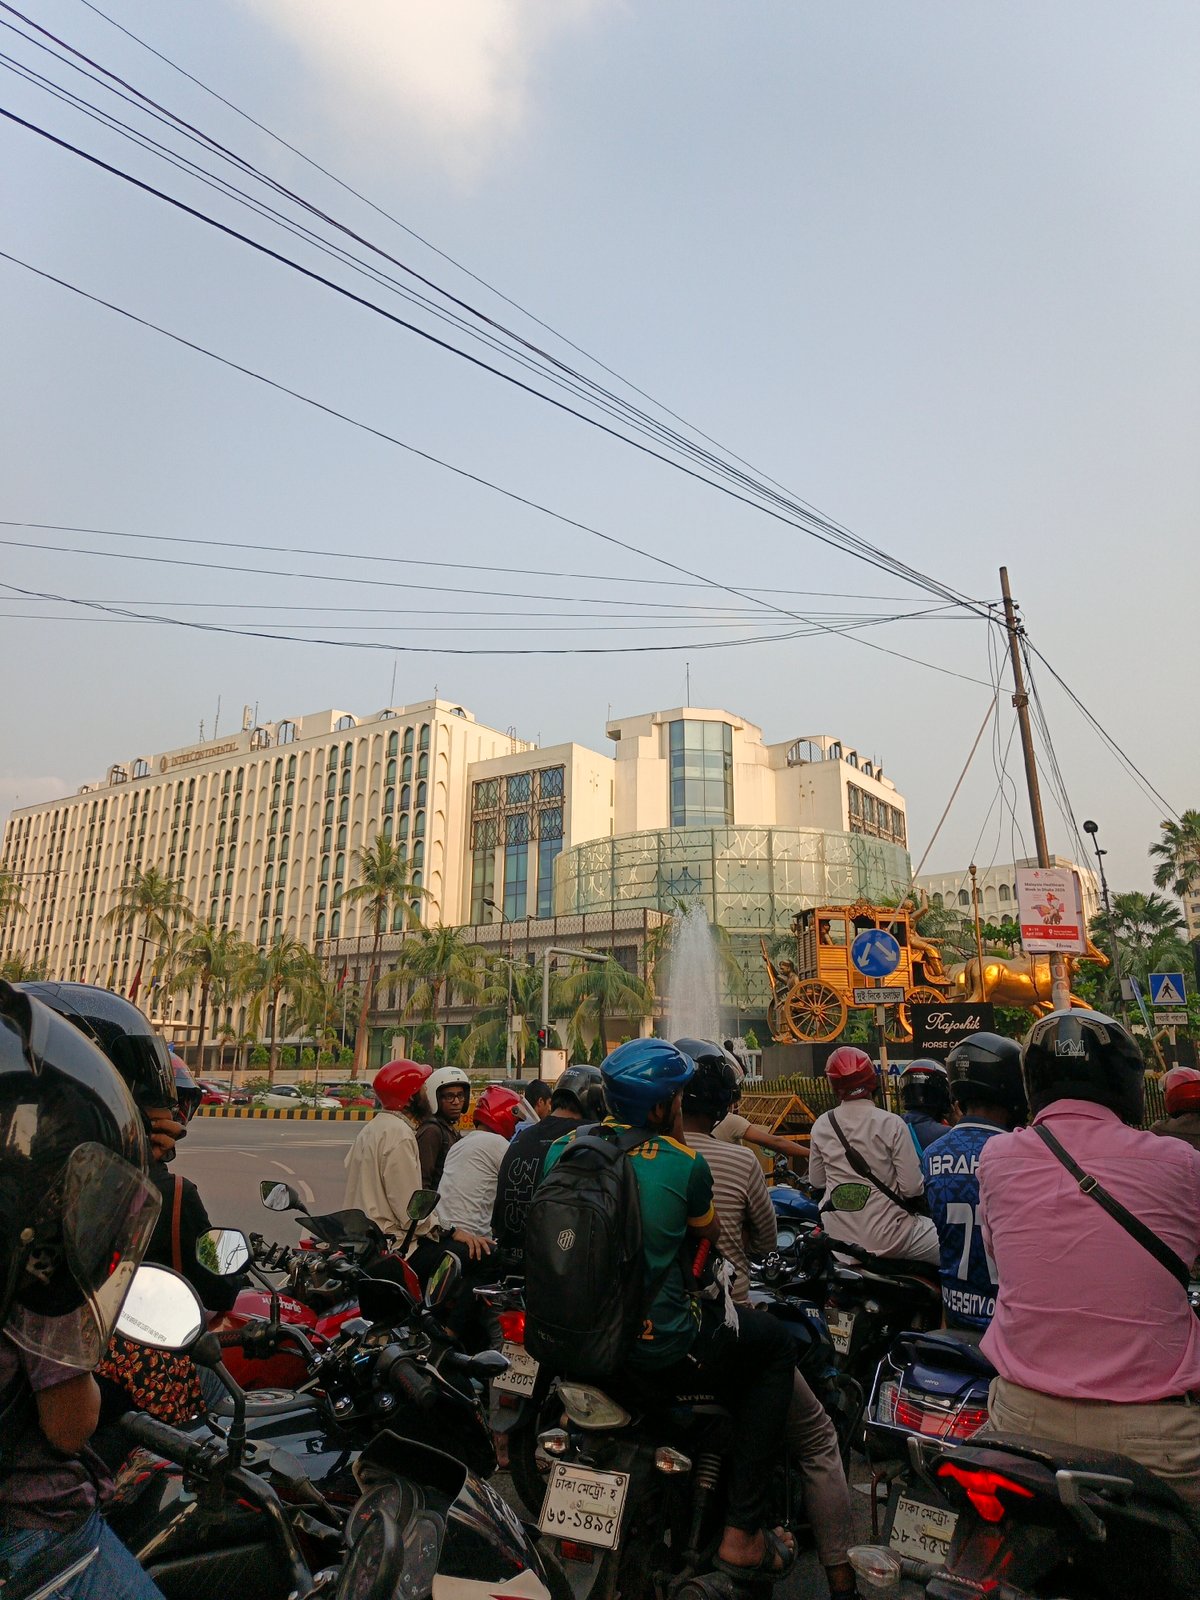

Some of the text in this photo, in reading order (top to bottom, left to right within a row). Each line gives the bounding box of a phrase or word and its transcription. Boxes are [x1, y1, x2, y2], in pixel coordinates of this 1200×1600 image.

[925, 1012, 980, 1034] Rajoshik
[922, 1041, 961, 1049] HORSE CA
[929, 1154, 979, 1176] IBRAH
[806, 1308, 820, 1318] TVS
[555, 1479, 576, 1492] ঢাকা
[898, 1501, 920, 1515] ঢাকা
